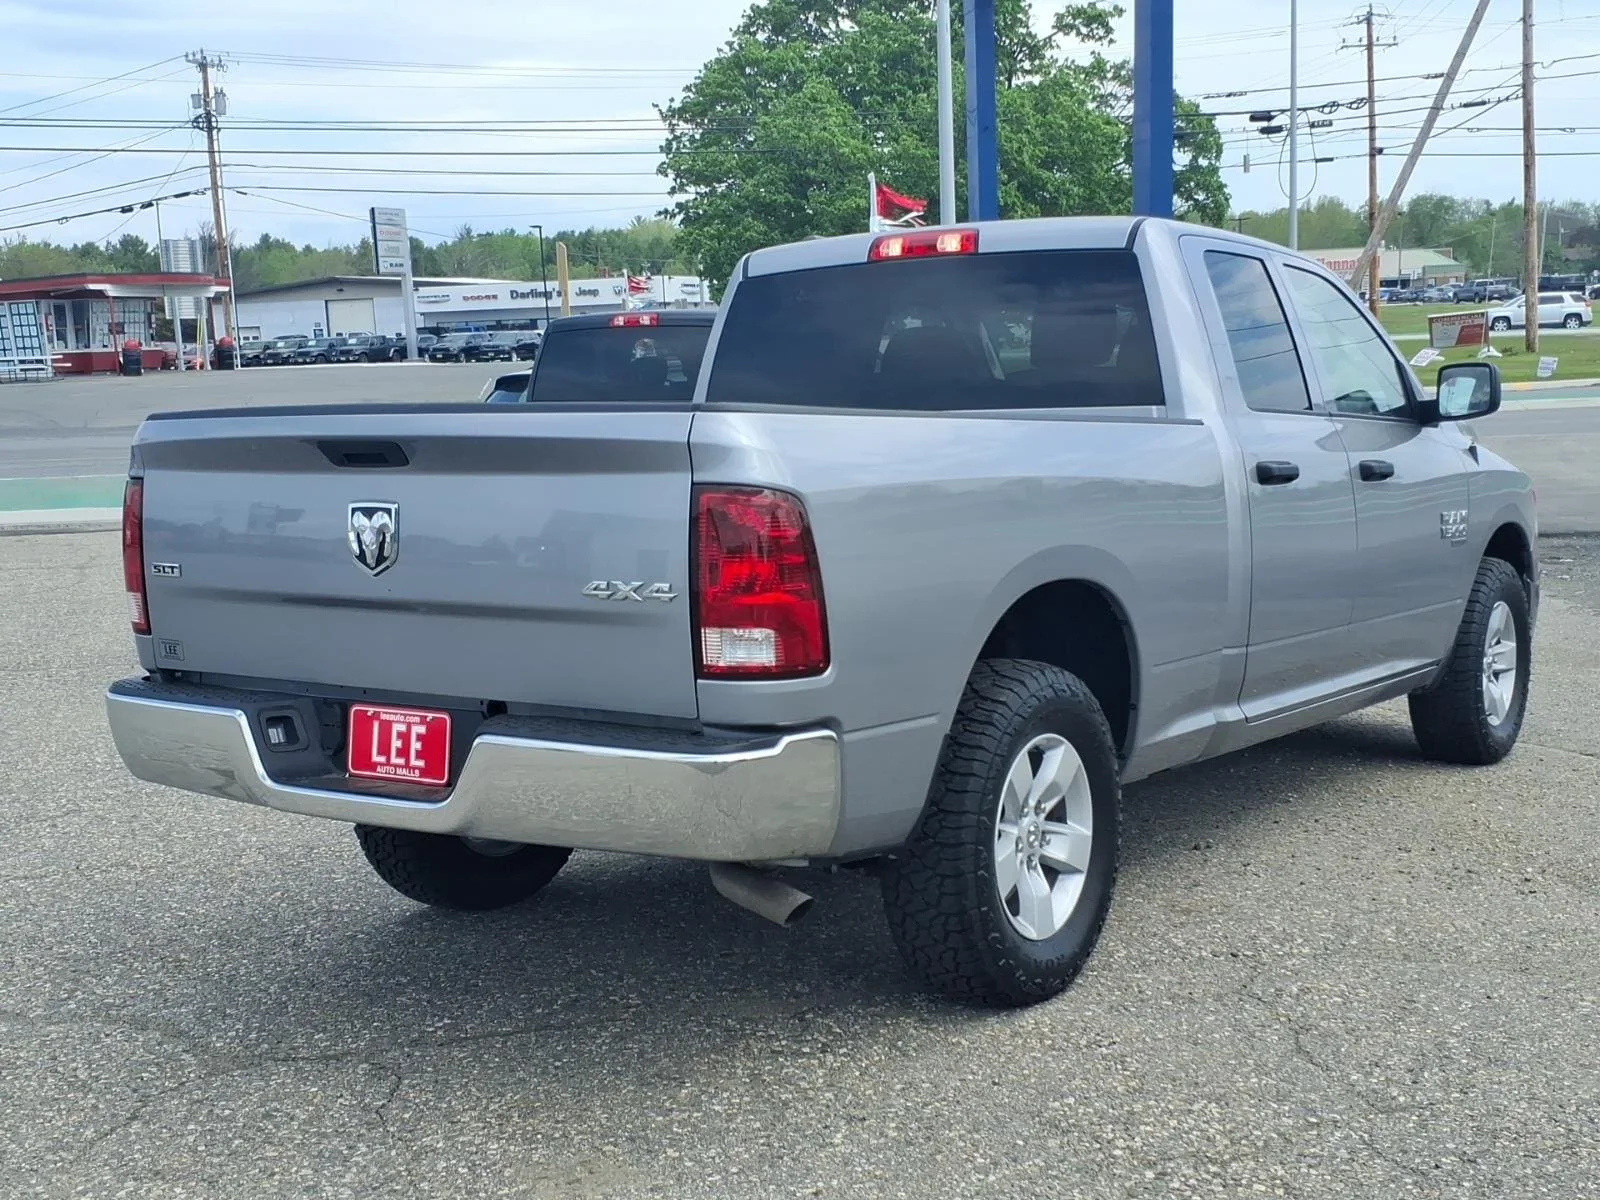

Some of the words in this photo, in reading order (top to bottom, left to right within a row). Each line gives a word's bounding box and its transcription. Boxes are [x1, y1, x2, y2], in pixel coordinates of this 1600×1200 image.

[509, 287, 562, 300] Darling's
[575, 286, 599, 297] Jeep
[462, 294, 498, 302] DODGE
[153, 565, 178, 575] SLT
[582, 580, 678, 602] 4X4
[164, 644, 180, 656] LEE
[380, 711, 420, 723] leeauto.com
[371, 720, 427, 769] LEE
[376, 765, 395, 775] AUTO
[396, 767, 420, 778] MALLS
